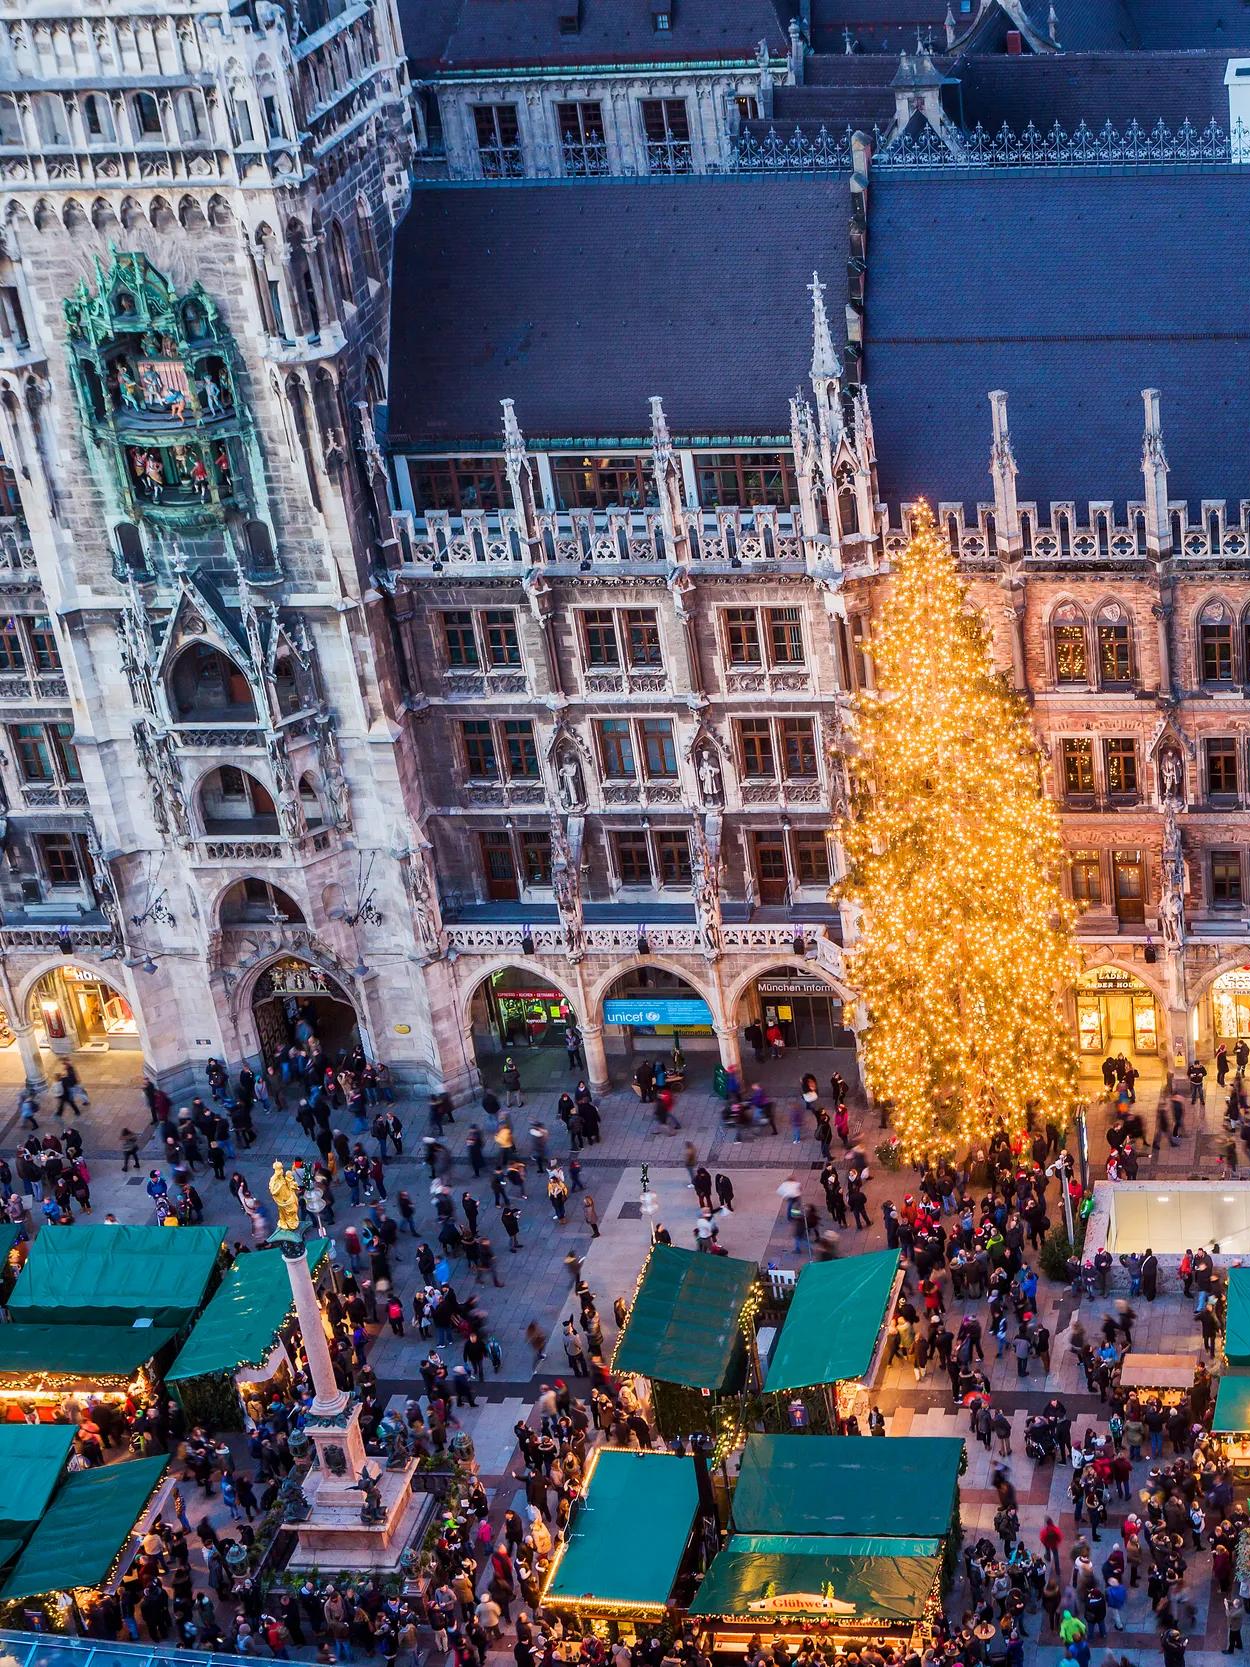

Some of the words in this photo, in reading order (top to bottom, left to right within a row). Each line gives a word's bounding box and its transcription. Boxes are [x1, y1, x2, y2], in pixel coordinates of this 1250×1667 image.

[757, 983, 801, 992] München
[607, 1011, 644, 1022] unicef
[772, 1599, 834, 1609] Glühwen
